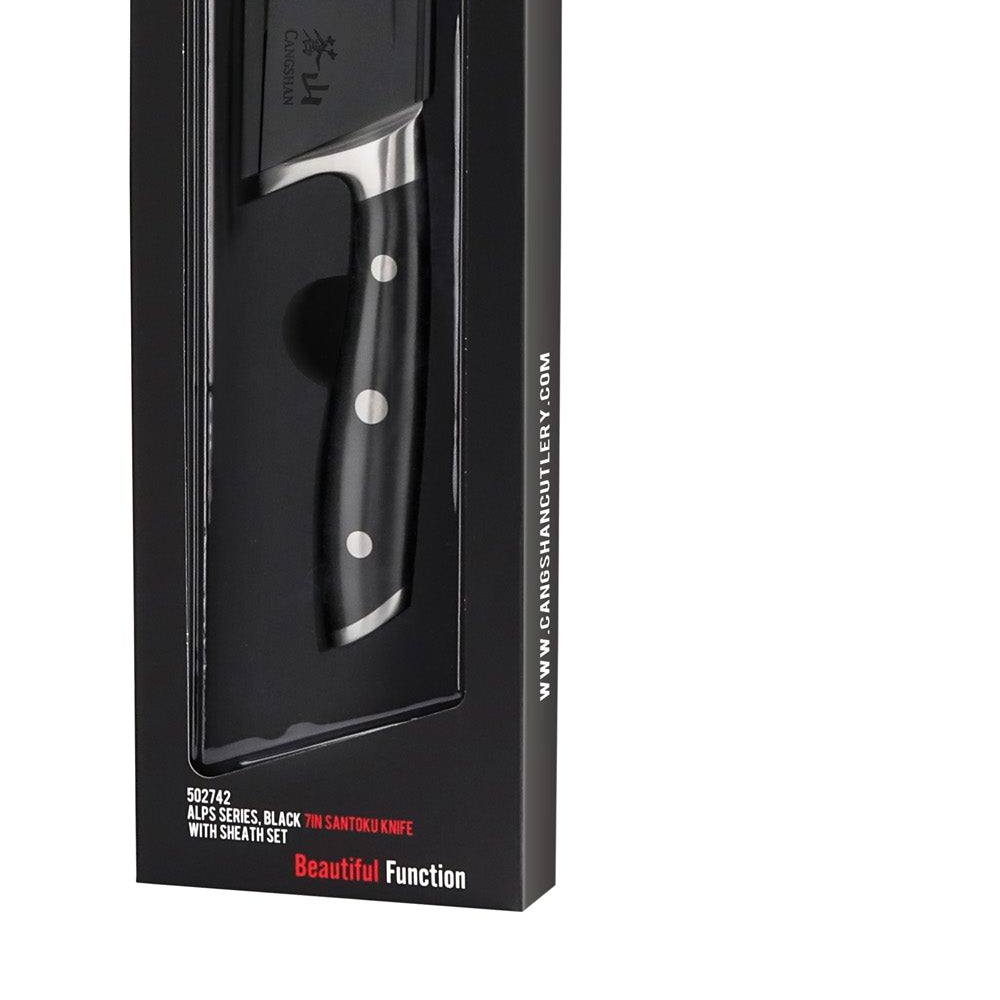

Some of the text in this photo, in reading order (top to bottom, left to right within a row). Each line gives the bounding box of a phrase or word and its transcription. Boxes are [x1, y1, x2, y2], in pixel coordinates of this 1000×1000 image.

[539, 352, 551, 702] WWW.CANGSHANCUTLERY.COM
[186, 787, 231, 805] 502742
[187, 805, 414, 836] ALPS SERIES, BLACK 7IN SANTOKU KNIFE
[188, 821, 288, 844] WITH SHEATH SET
[294, 853, 466, 890] Beautiful Function
